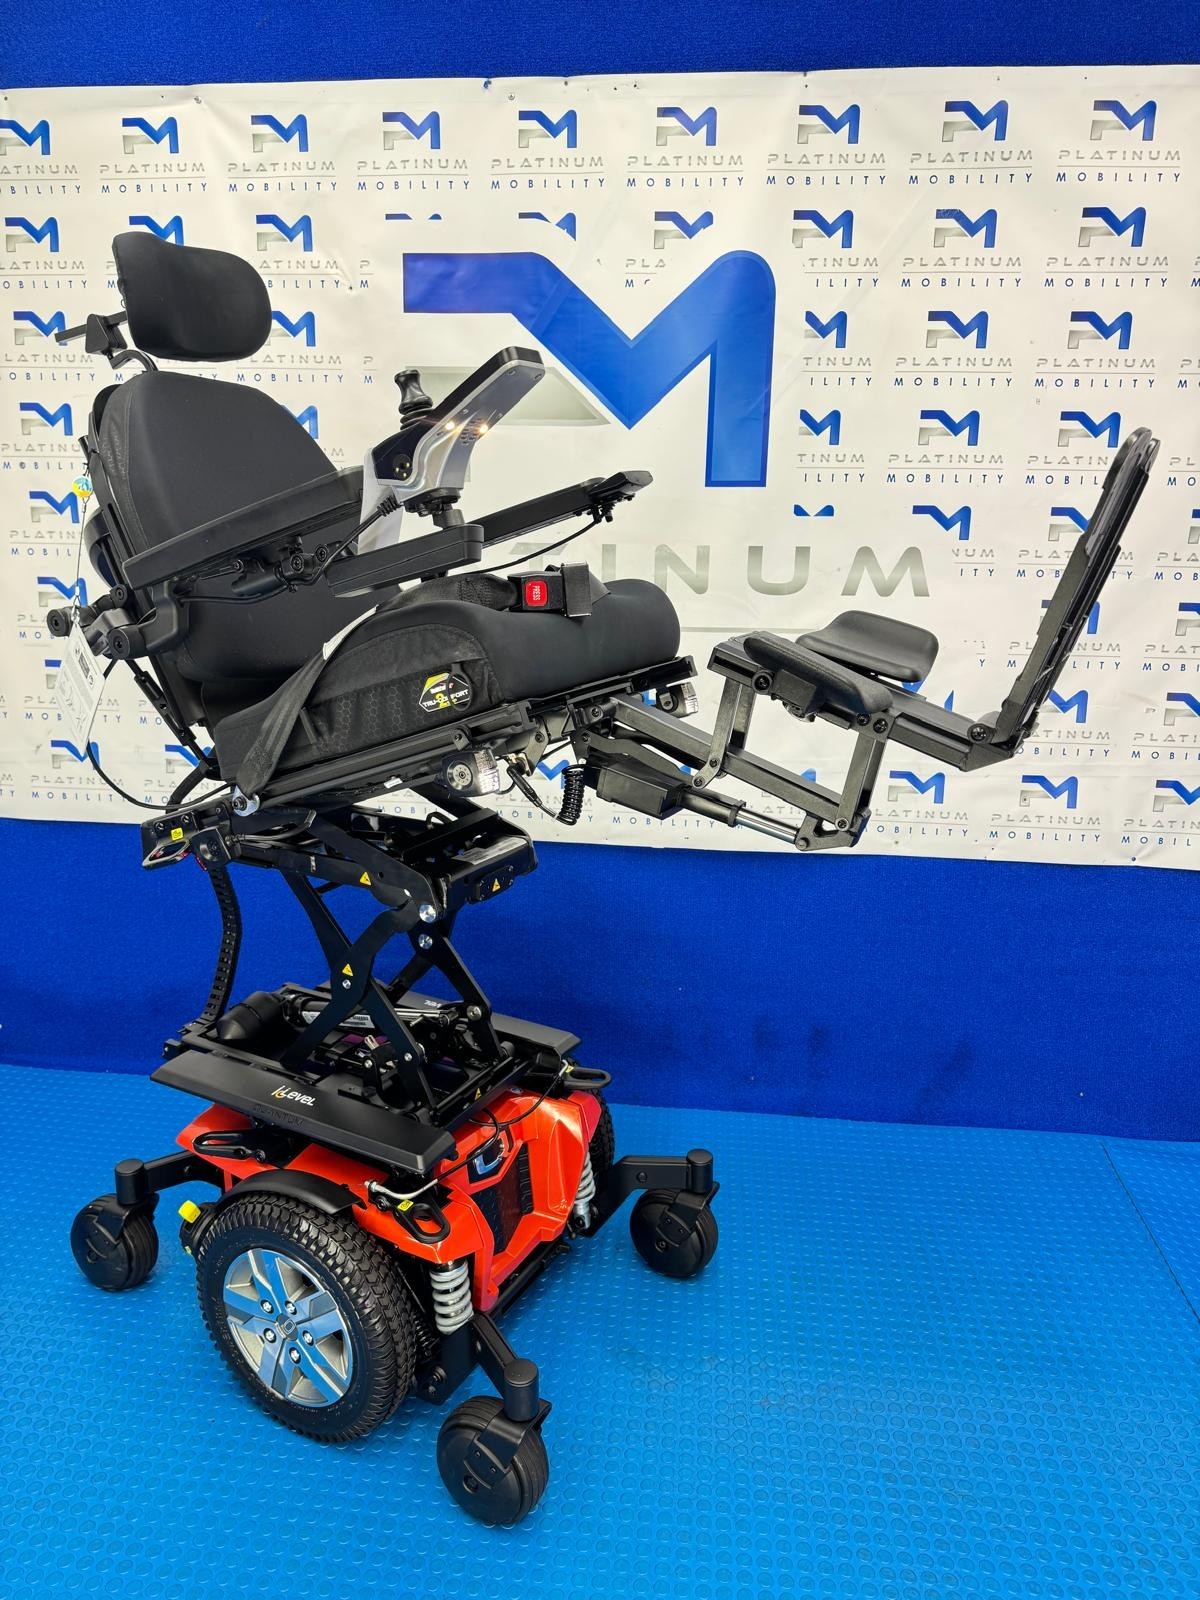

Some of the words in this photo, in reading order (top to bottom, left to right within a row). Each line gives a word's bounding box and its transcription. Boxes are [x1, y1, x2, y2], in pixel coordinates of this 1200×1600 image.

[627, 155, 743, 166] PLATINUM
[768, 153, 885, 165] PLATINUM
[910, 150, 1032, 163] PLATINUM
[1059, 150, 1180, 160] PLATINUM
[228, 161, 335, 172] PLATINUM
[357, 159, 468, 170] PLATINUM
[491, 156, 603, 168] PLATINUM
[98, 163, 205, 174] PLATINUM
[627, 177, 743, 187] MOBILITY
[766, 175, 886, 185] MOBILITY
[909, 173, 1032, 184] MOBILITY
[1056, 172, 1180, 182] MOBILITY
[0, 185, 80, 194] BILITY
[101, 183, 207, 193] MOBILITY
[229, 181, 336, 192] MOBILITY
[358, 180, 469, 191] MOBILITY
[491, 178, 604, 190] MOBILITY
[903, 257, 1021, 267] PLATINUM
[1047, 256, 1168, 266] PLATINUM
[901, 278, 1021, 287] MOBILITY
[1044, 278, 1168, 287] MOBILITY
[896, 357, 1012, 367] PLATINUM
[1036, 358, 1155, 368] PLATINUM
[234, 373, 343, 385] MOBILITY
[894, 377, 1012, 387] MOBILITY
[1034, 378, 1154, 389] MOBILITY
[888, 454, 1003, 464] PLATINUM
[886, 473, 1003, 484] MOBILITY
[532, 586, 541, 600] PRESS
[990, 814, 1100, 827] PLATINUM
[864, 825, 969, 838] OBILITY
[989, 831, 1100, 842] MOBILITY
